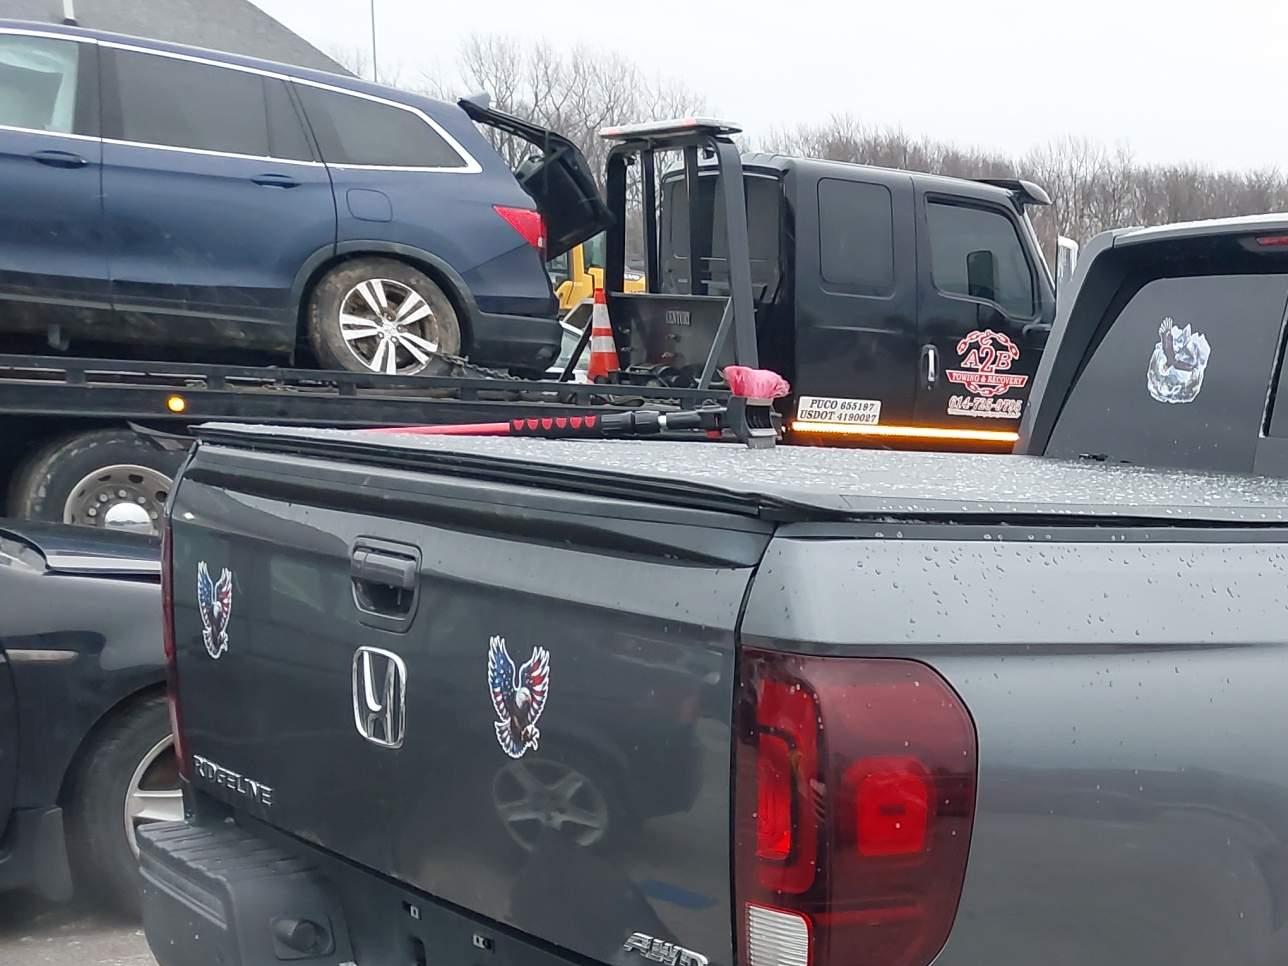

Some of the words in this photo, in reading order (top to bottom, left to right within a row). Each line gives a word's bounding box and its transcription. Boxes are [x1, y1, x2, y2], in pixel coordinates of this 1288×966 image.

[961, 346, 1013, 375] A2B
[952, 373, 980, 383] TOWING
[988, 376, 1023, 386] RECOVERY
[809, 399, 838, 410] PUCO
[840, 402, 874, 411] 655197
[799, 410, 835, 420] USDOT
[837, 413, 877, 423] 4190027
